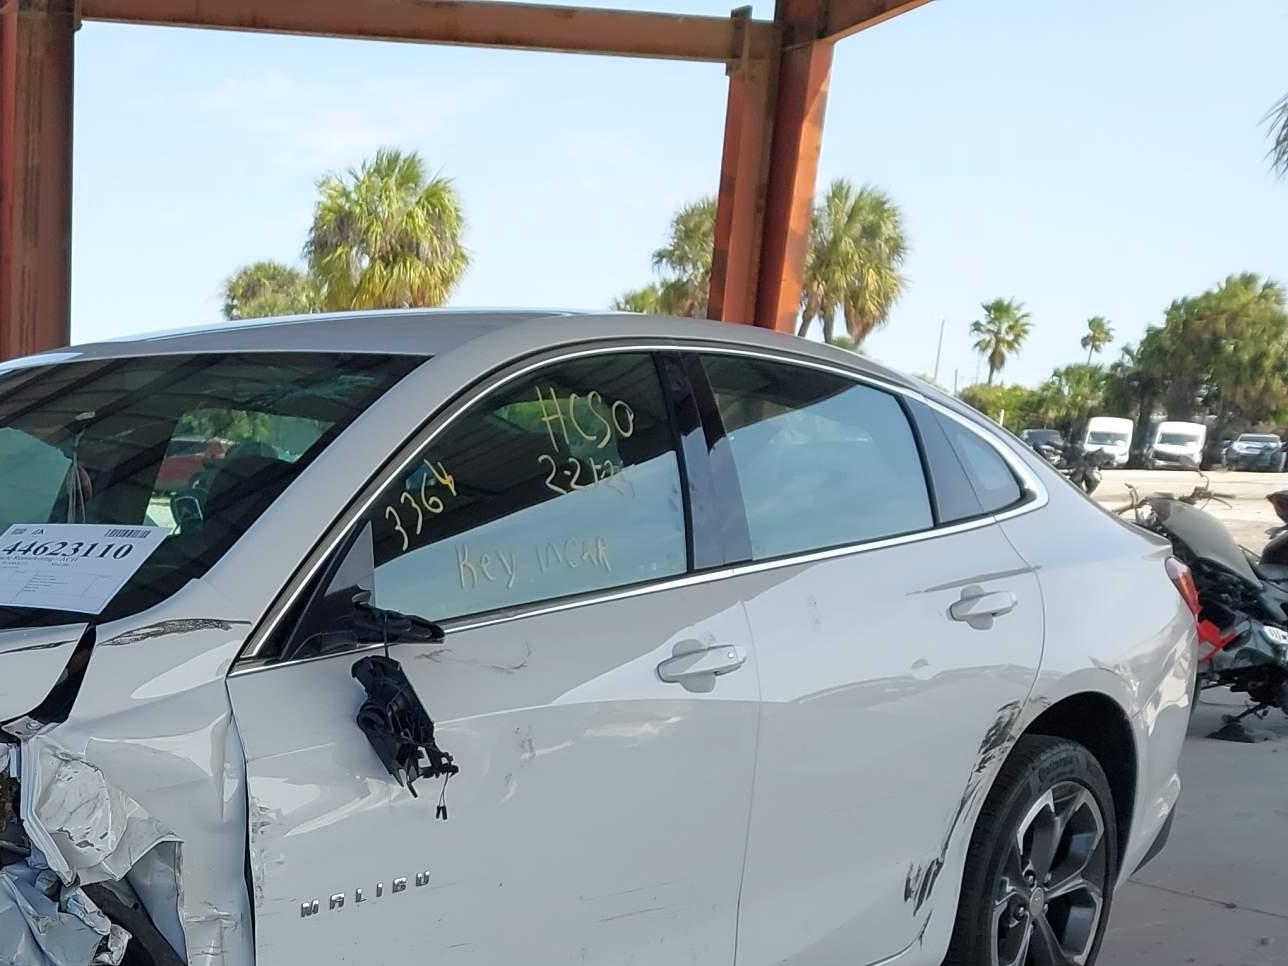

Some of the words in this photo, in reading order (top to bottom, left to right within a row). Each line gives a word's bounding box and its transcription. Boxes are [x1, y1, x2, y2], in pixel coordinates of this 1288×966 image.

[535, 386, 634, 453] HCSO
[385, 458, 457, 551] 3364
[1, 540, 134, 559] 44623110
[300, 870, 431, 918] MALIBU
